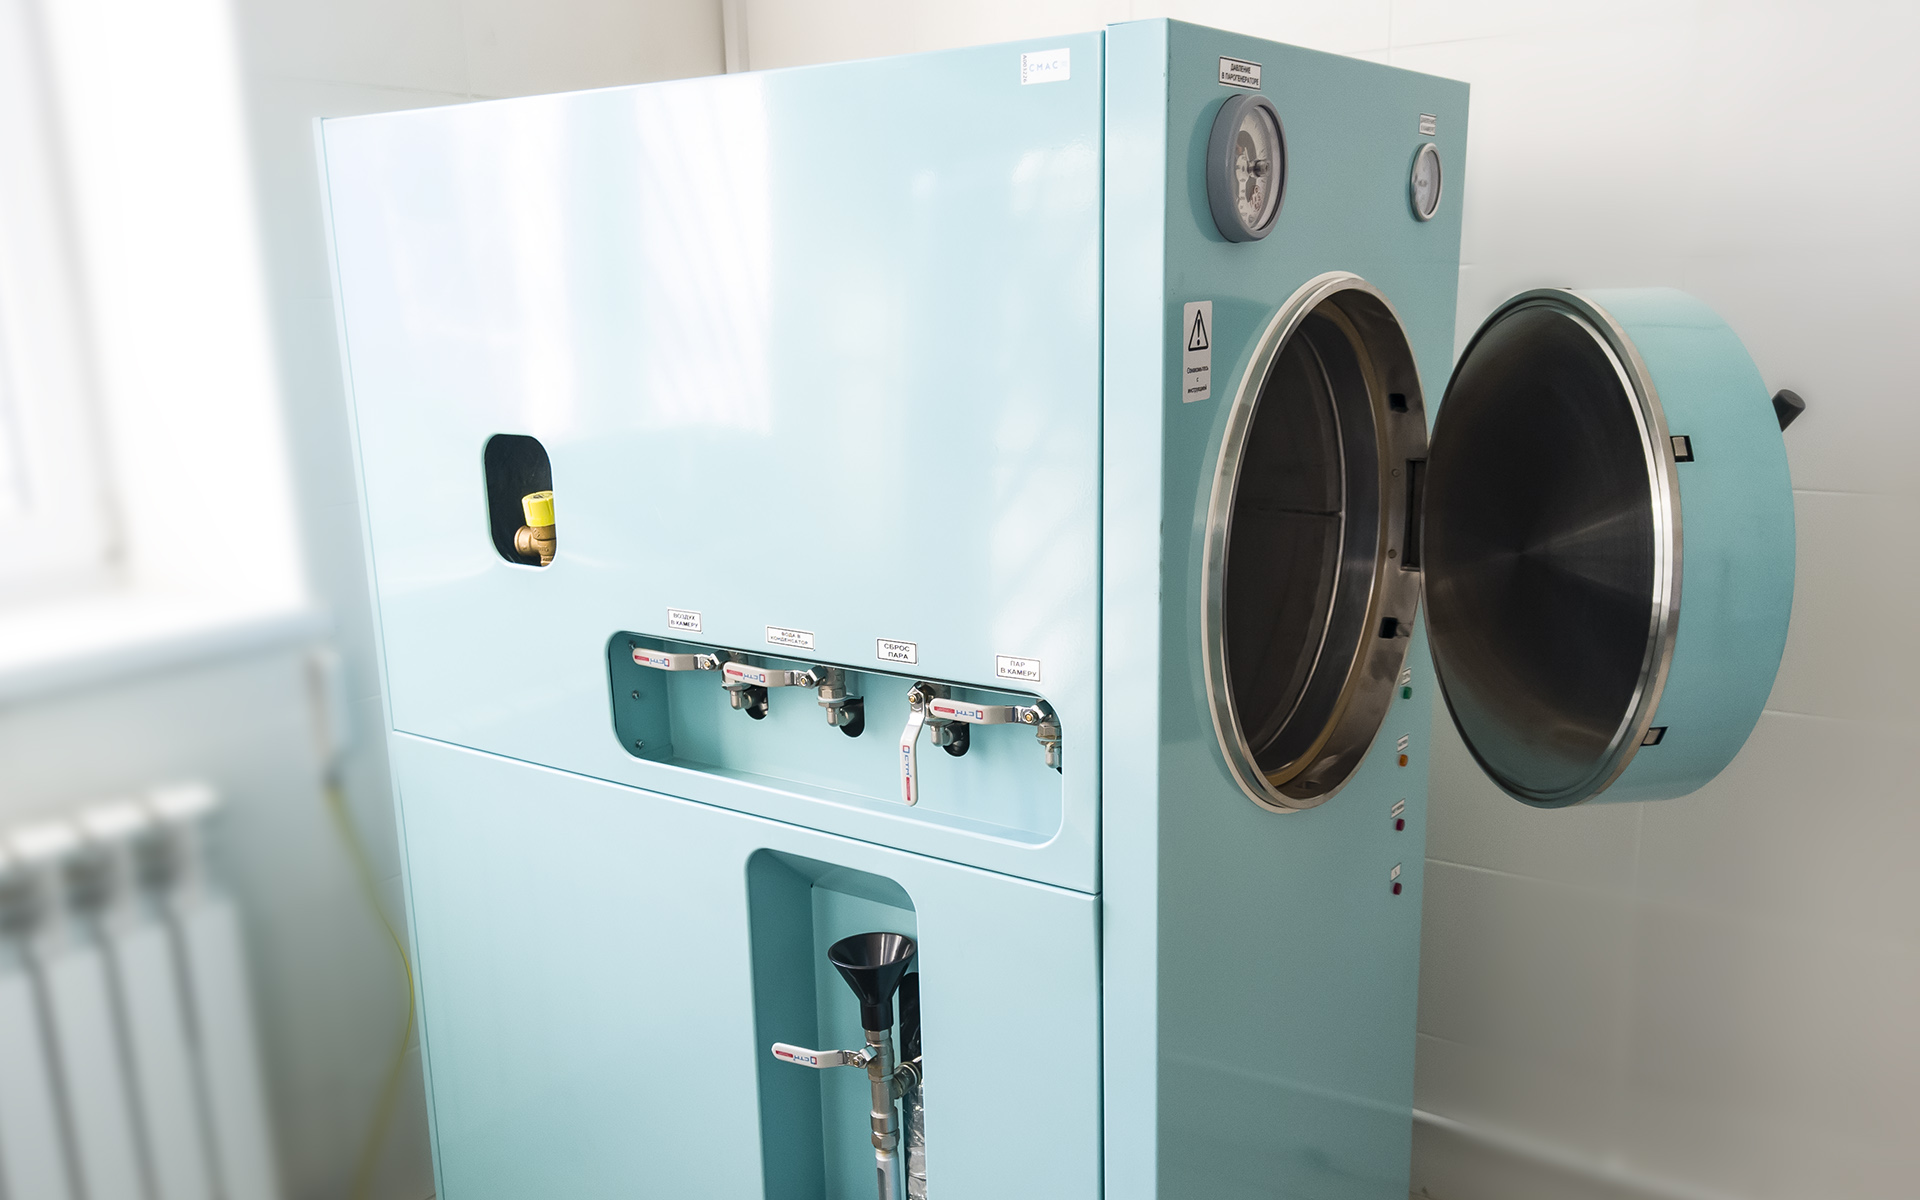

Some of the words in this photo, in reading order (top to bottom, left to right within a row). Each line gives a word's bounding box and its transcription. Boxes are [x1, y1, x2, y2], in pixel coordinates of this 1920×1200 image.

[676, 620, 699, 628] КАМЕРУ
[884, 643, 910, 652] СБРОС
[888, 652, 908, 660] ПАРА
[1007, 668, 1037, 678] КАМЕРУ
